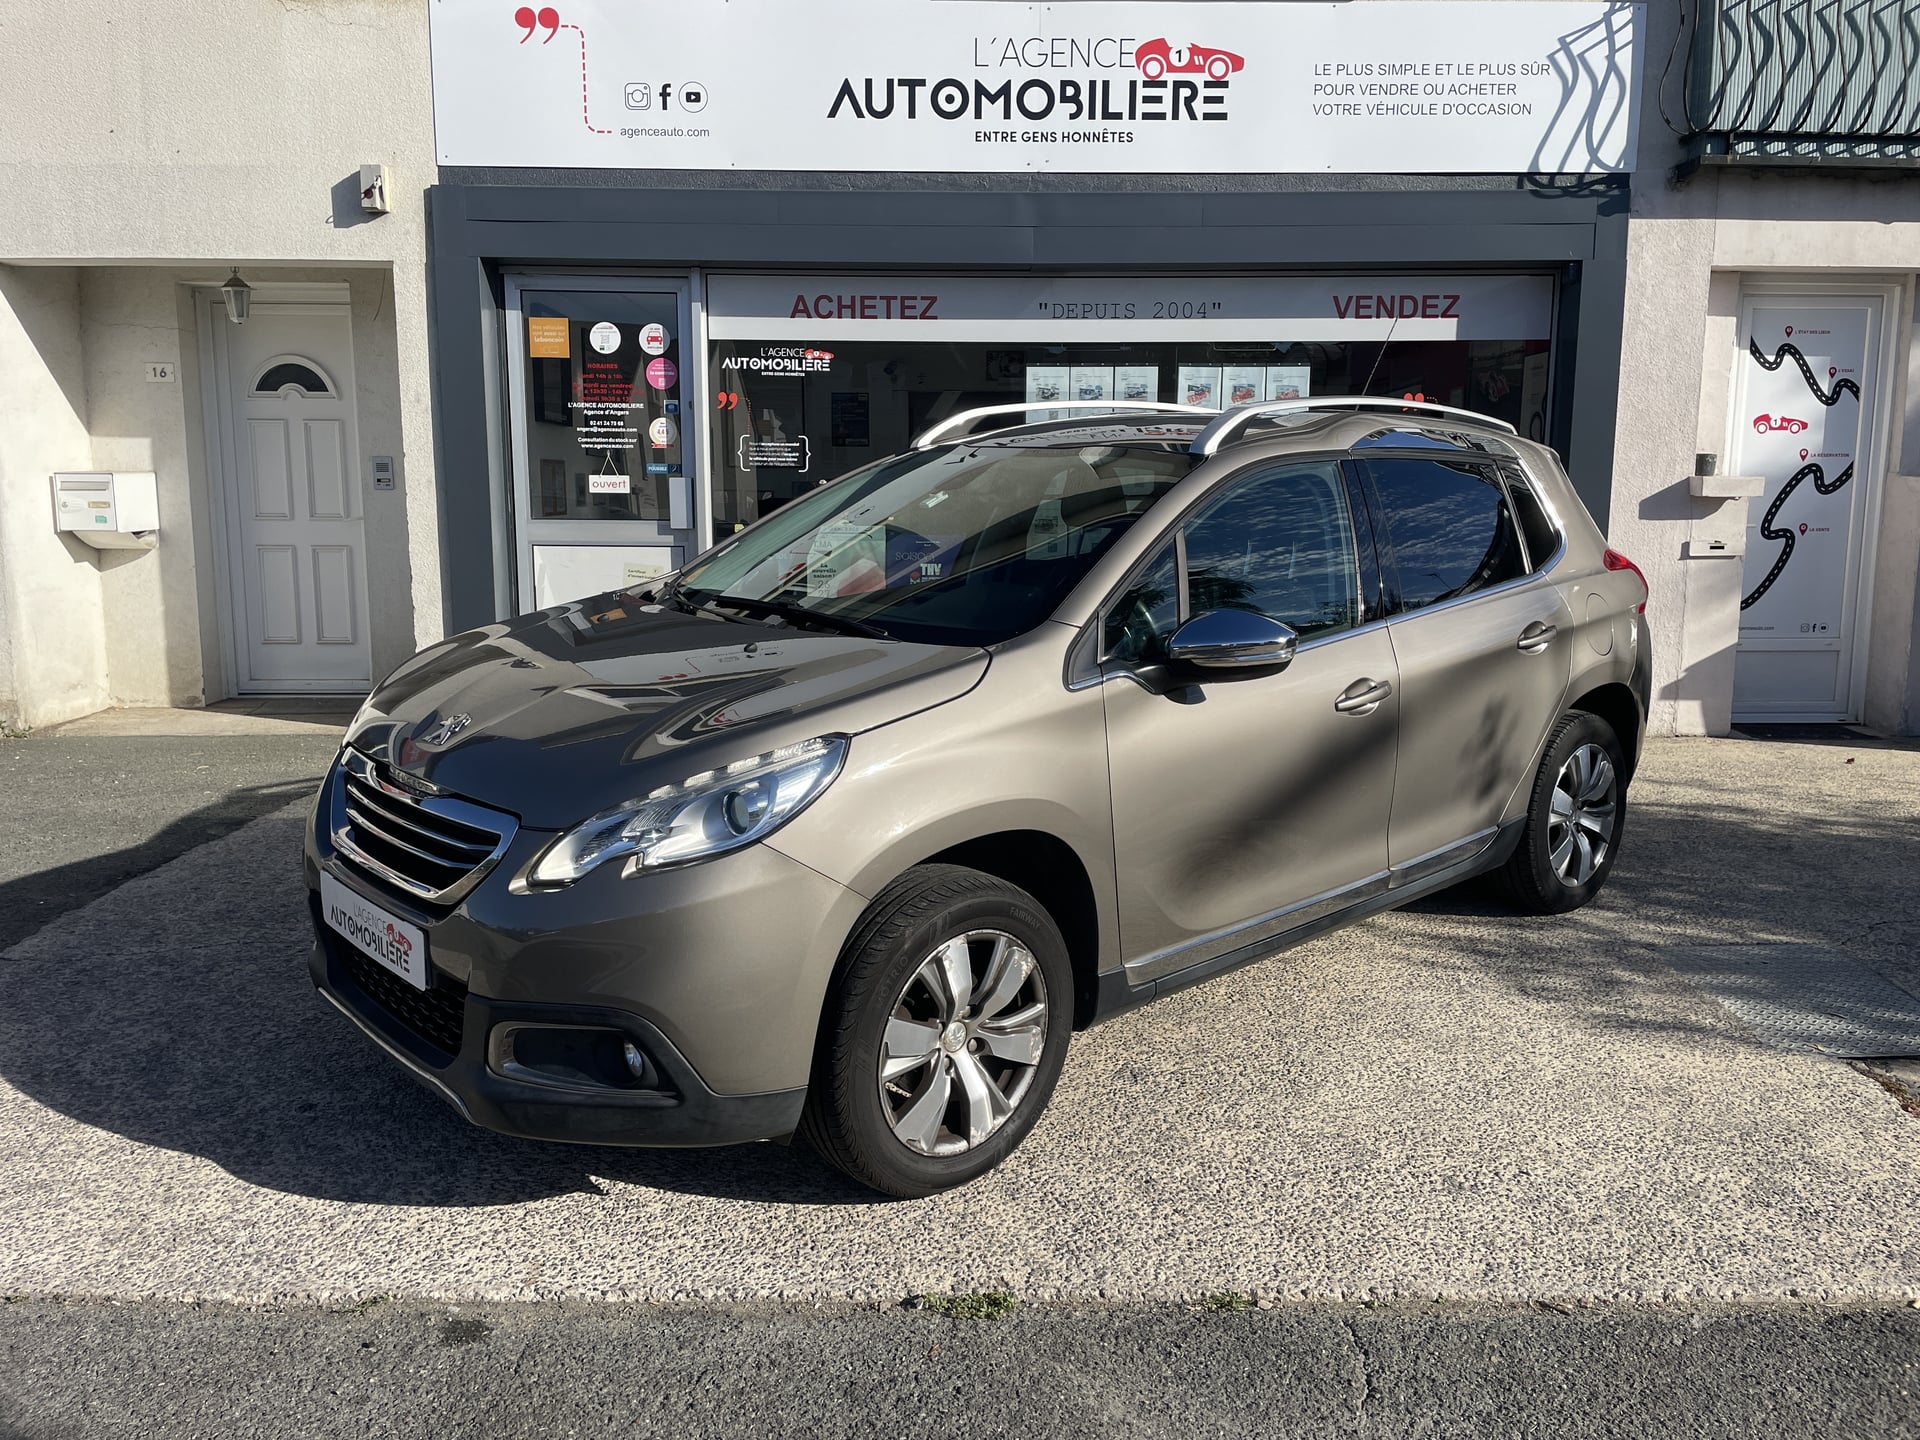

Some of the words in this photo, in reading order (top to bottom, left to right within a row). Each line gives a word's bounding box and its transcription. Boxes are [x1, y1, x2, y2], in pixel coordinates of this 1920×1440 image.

[975, 37, 1136, 68] L'AGENCE
[1314, 63, 1332, 76] LE
[1336, 63, 1374, 76] PLUS
[1378, 63, 1431, 76] SIMPLE
[1434, 63, 1453, 76] ET
[1457, 63, 1474, 76] LE
[1479, 63, 1517, 76] PLUS
[1520, 61, 1551, 76] SÛR
[1313, 83, 1355, 96] POUR
[1359, 83, 1419, 96] VENDRE
[1423, 83, 1445, 96] OU
[1448, 83, 1517, 96] ACHETER
[1312, 103, 1362, 116] VOTRE
[1366, 101, 1438, 116] VÉHICULE
[1442, 103, 1532, 116] D'OCCASION
[620, 127, 710, 139] agenceauto.com
[975, 131, 1018, 143] ENTRE
[1021, 131, 1057, 143] GENS
[1061, 128, 1134, 144] HONNÊTES
[790, 294, 939, 320] ACHETEZ
[1332, 294, 1461, 320] VENDEZ
[761, 347, 805, 358] L'AGENCE
[152, 367, 167, 378] 16
[592, 479, 626, 489] ouvert
[1009, 907, 1041, 930] FAIRWAY
